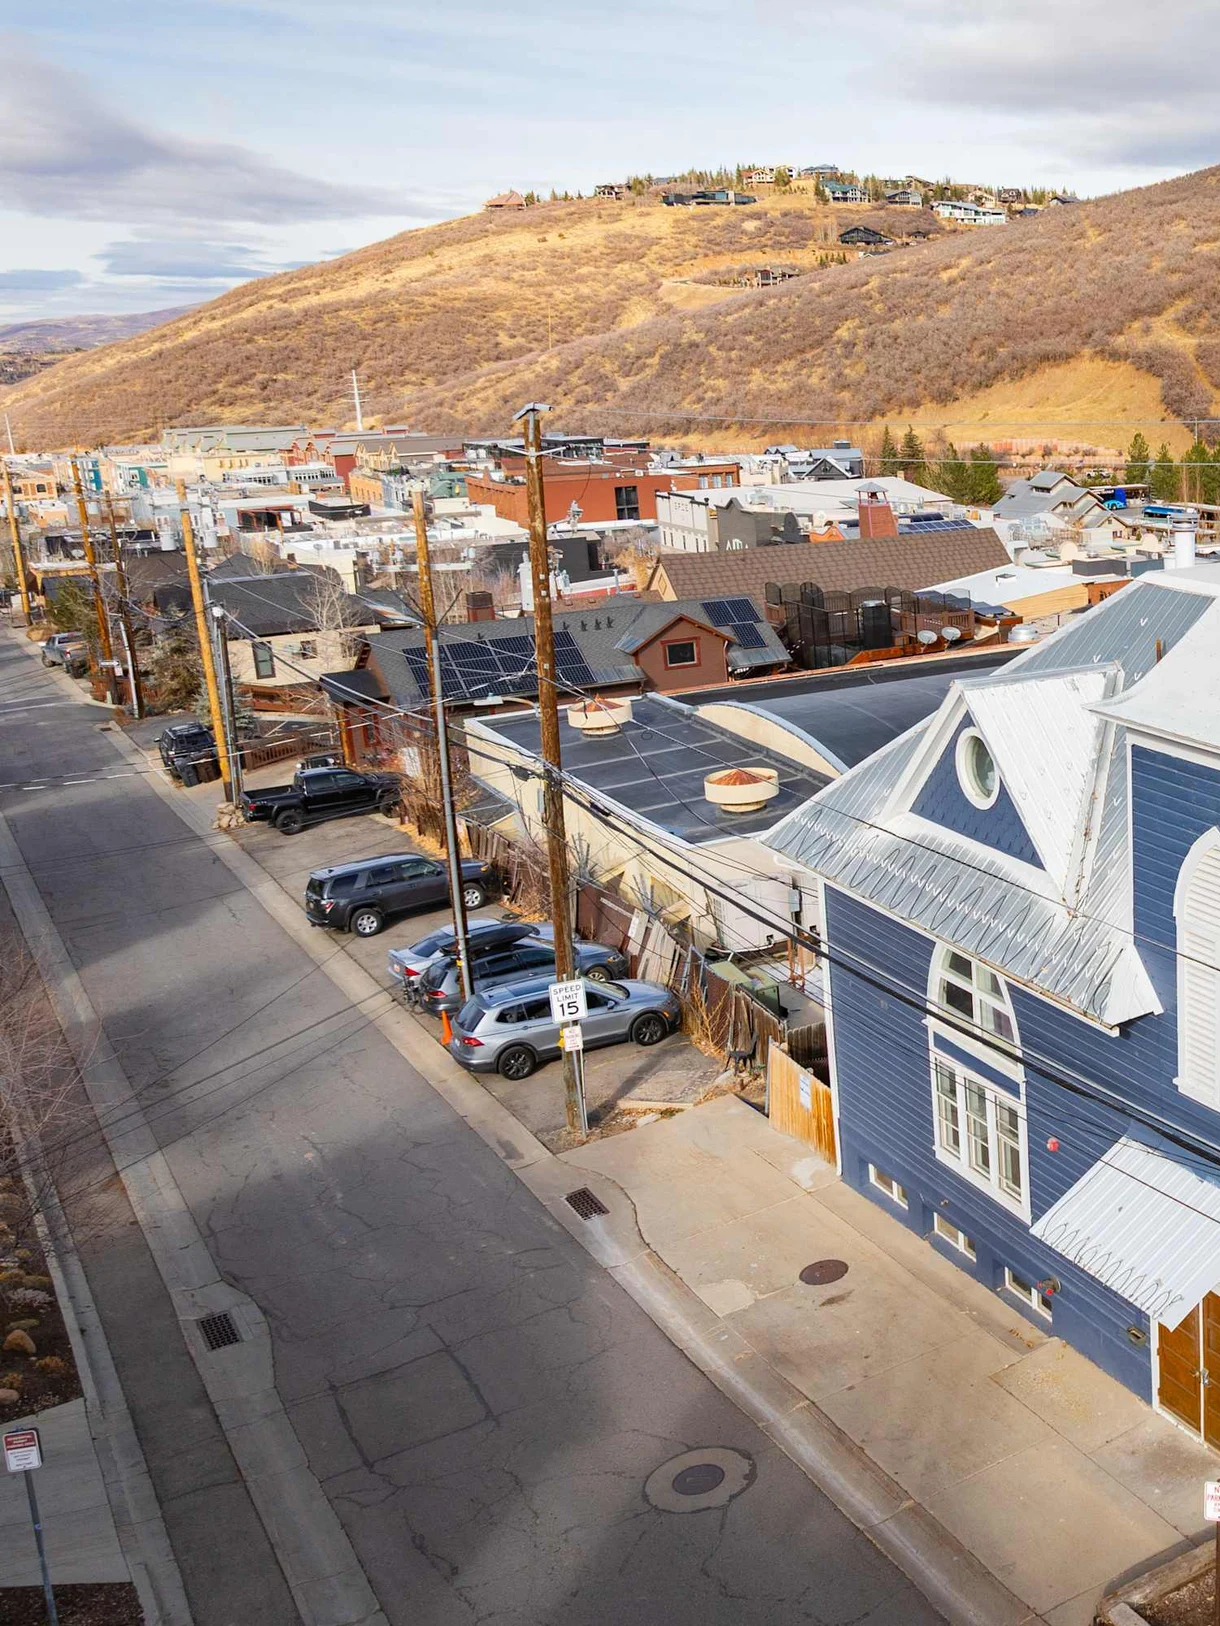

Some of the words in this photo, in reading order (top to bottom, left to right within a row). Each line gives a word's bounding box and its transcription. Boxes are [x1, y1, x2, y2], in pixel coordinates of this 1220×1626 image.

[553, 984, 581, 995] SPEED
[557, 992, 579, 1002] LIMIT
[559, 1000, 579, 1017] 15
